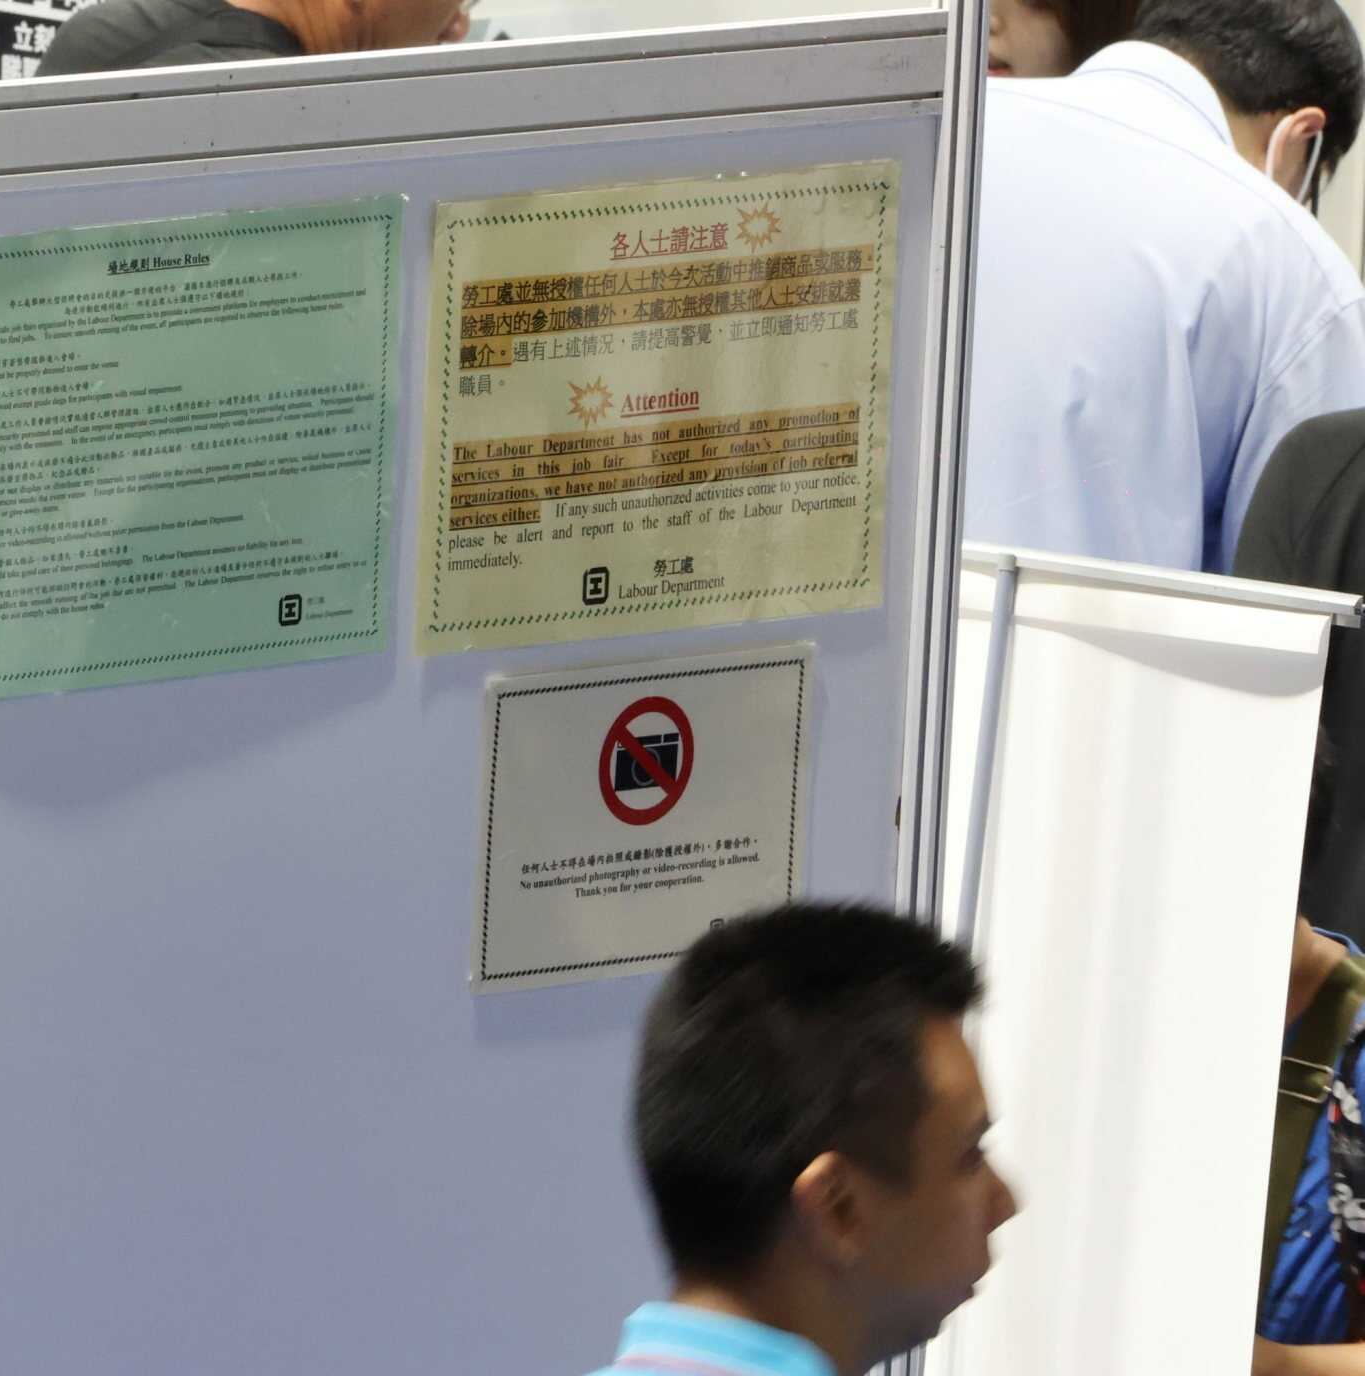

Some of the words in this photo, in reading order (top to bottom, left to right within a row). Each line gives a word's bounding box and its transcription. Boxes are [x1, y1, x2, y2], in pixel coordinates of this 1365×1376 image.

[610, 222, 728, 257] 各人士請注意
[152, 256, 182, 268] House
[184, 253, 210, 265] Rules
[621, 386, 699, 413] Attention
[453, 446, 477, 462] The
[486, 440, 534, 458] Labour
[542, 432, 615, 455] Department
[623, 431, 643, 444] has
[652, 427, 670, 441] not
[678, 419, 740, 438] authorized
[750, 418, 770, 432] any
[778, 408, 838, 430] promotion
[847, 406, 859, 420] of
[449, 511, 498, 528] services
[501, 505, 541, 523] either.
[555, 503, 567, 517] If
[567, 505, 586, 519] any
[590, 498, 617, 513] such
[620, 490, 692, 511] unauthorized
[695, 485, 744, 501] activities
[747, 484, 776, 496] come
[779, 480, 791, 493] to
[794, 479, 819, 495] your
[822, 473, 860, 489] notice.
[447, 535, 484, 552] please
[493, 531, 508, 545] be
[516, 527, 543, 542] alert
[551, 526, 573, 539] and
[580, 524, 615, 540] report
[623, 520, 634, 532] to
[640, 516, 659, 530] the
[666, 512, 693, 526] staff
[698, 510, 712, 523] of
[718, 507, 736, 521] the
[743, 503, 782, 519] Labour
[791, 494, 857, 517] Department
[447, 551, 523, 574] immediately.
[653, 557, 694, 576] 勞工處
[618, 582, 659, 599] Labour
[660, 575, 725, 597] Department
[519, 880, 532, 892] No
[533, 874, 587, 890] unauthorized
[589, 867, 639, 885] photography
[642, 865, 651, 876] or
[653, 857, 716, 877] video-recording
[718, 854, 725, 865] is
[726, 850, 761, 865] allowed.
[575, 886, 601, 898] Thank
[602, 885, 618, 898] you
[619, 881, 631, 893] for
[633, 882, 652, 894] your
[654, 873, 705, 890] cooperation.
